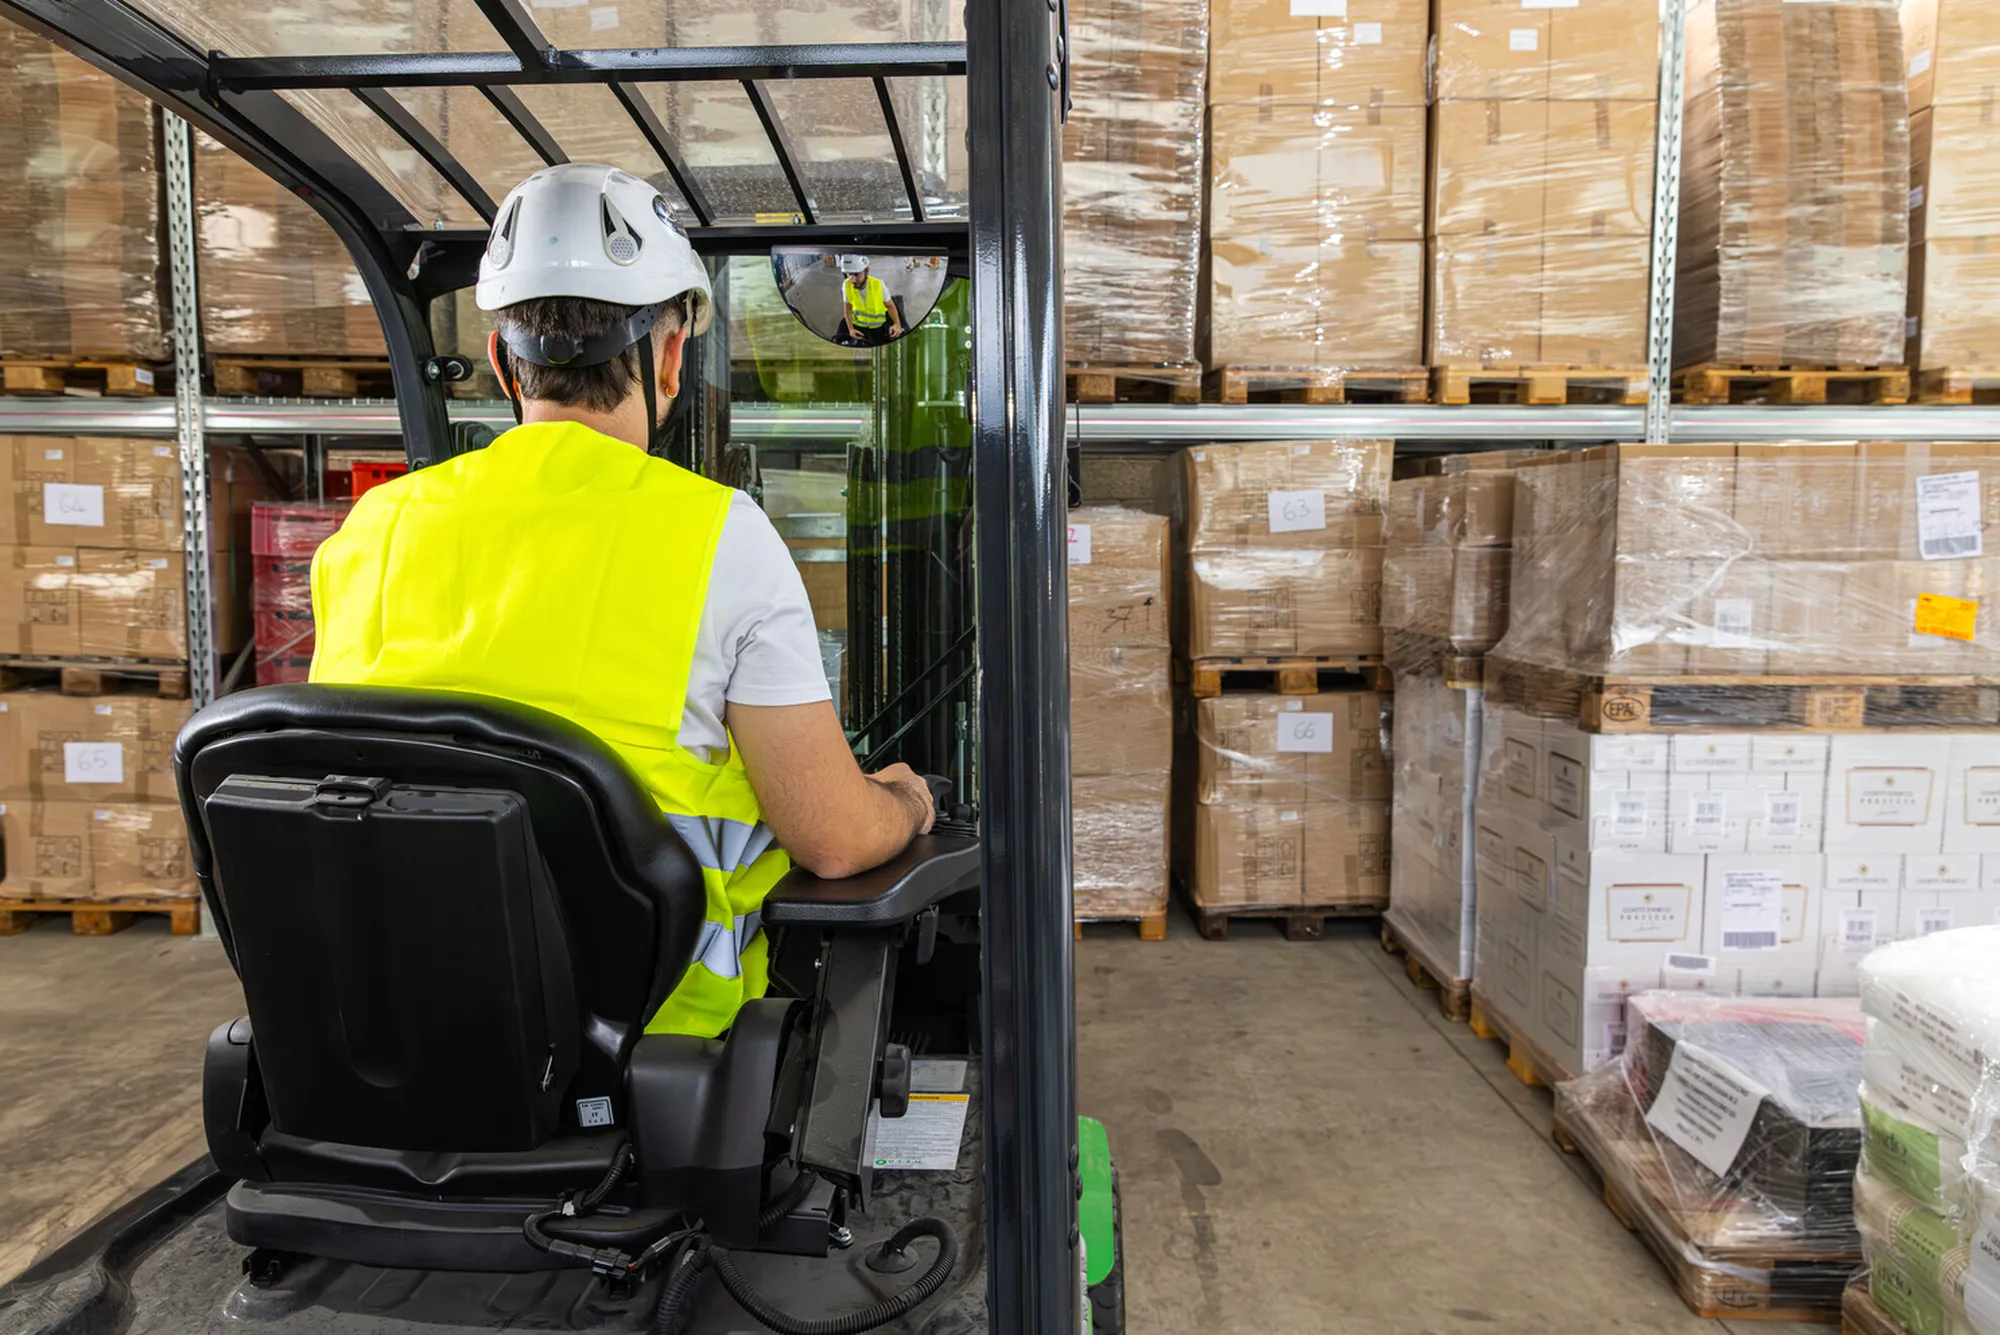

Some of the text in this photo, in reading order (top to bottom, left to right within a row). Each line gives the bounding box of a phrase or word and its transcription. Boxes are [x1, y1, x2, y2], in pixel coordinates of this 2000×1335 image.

[59, 493, 89, 514] 64
[1282, 499, 1310, 522] 63
[1293, 722, 1316, 740] 66
[77, 749, 107, 771] 65
